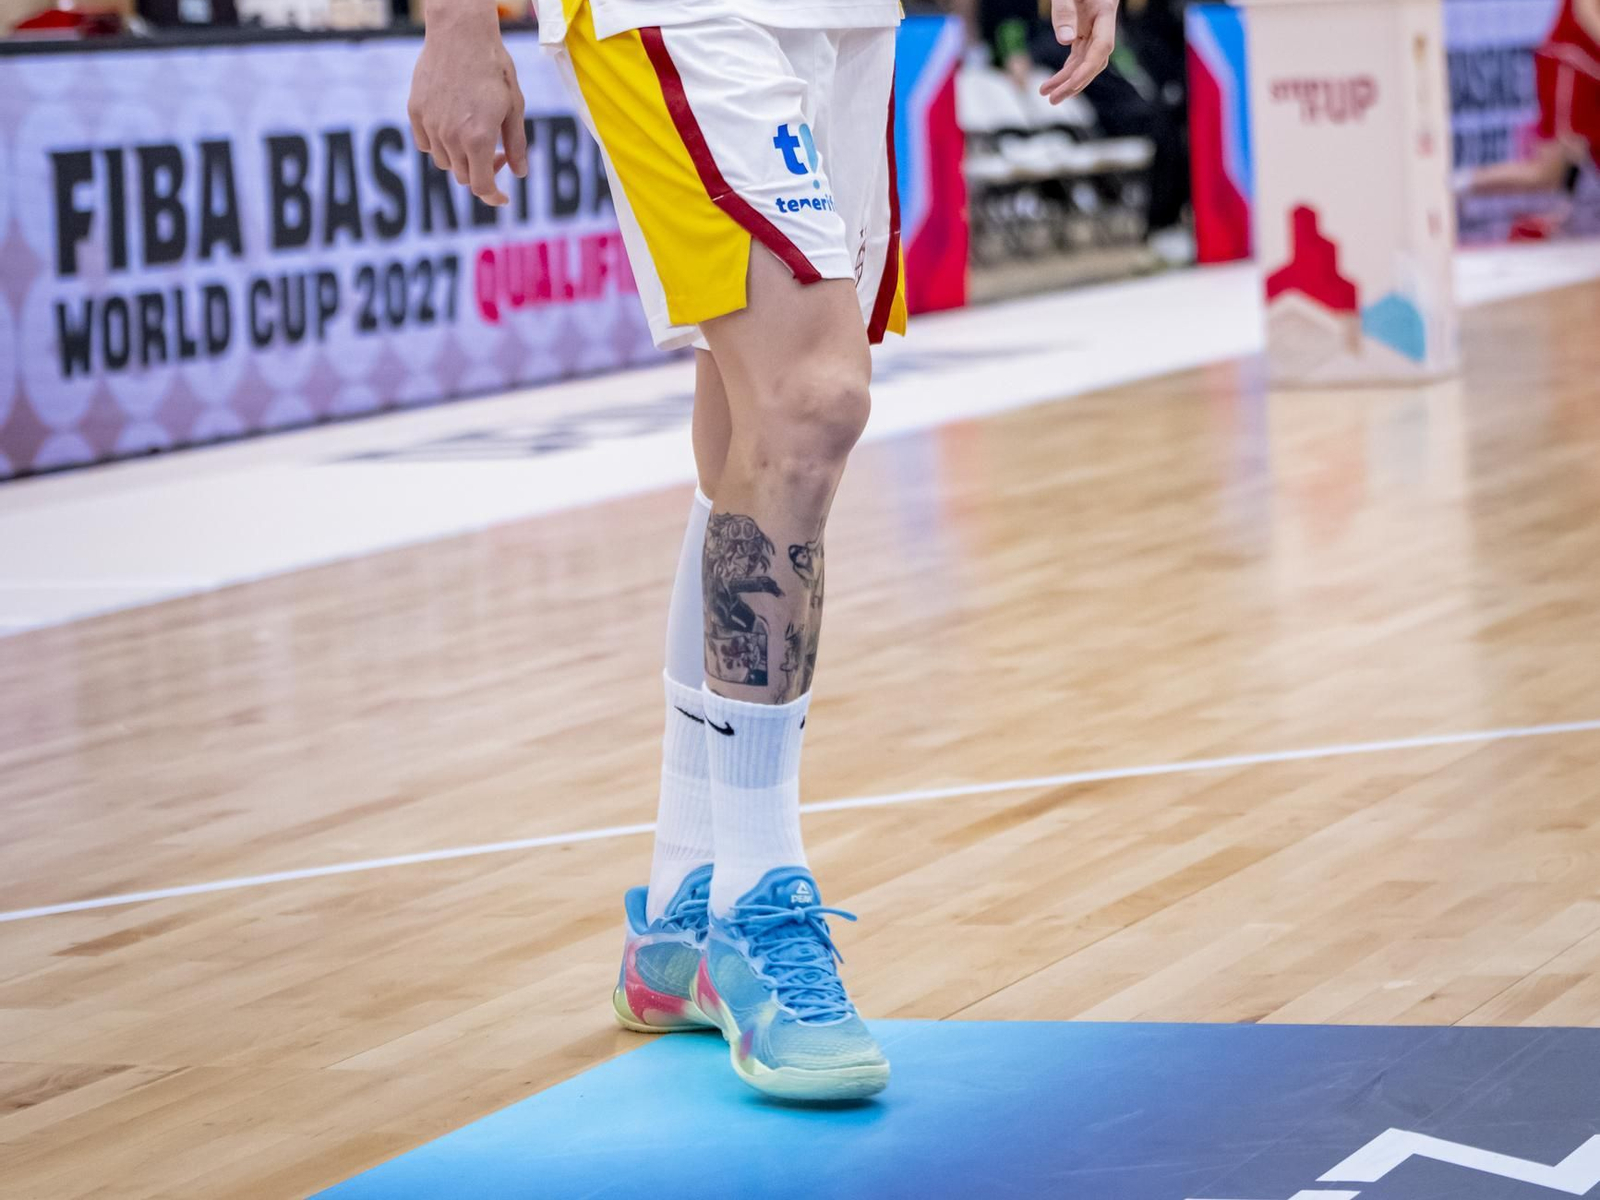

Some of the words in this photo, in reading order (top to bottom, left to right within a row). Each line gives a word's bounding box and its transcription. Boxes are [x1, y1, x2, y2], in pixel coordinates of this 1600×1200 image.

[51, 139, 243, 277] FIBA
[56, 284, 231, 378] WORLD
[250, 270, 339, 348] CUP
[355, 253, 458, 334] 2027
